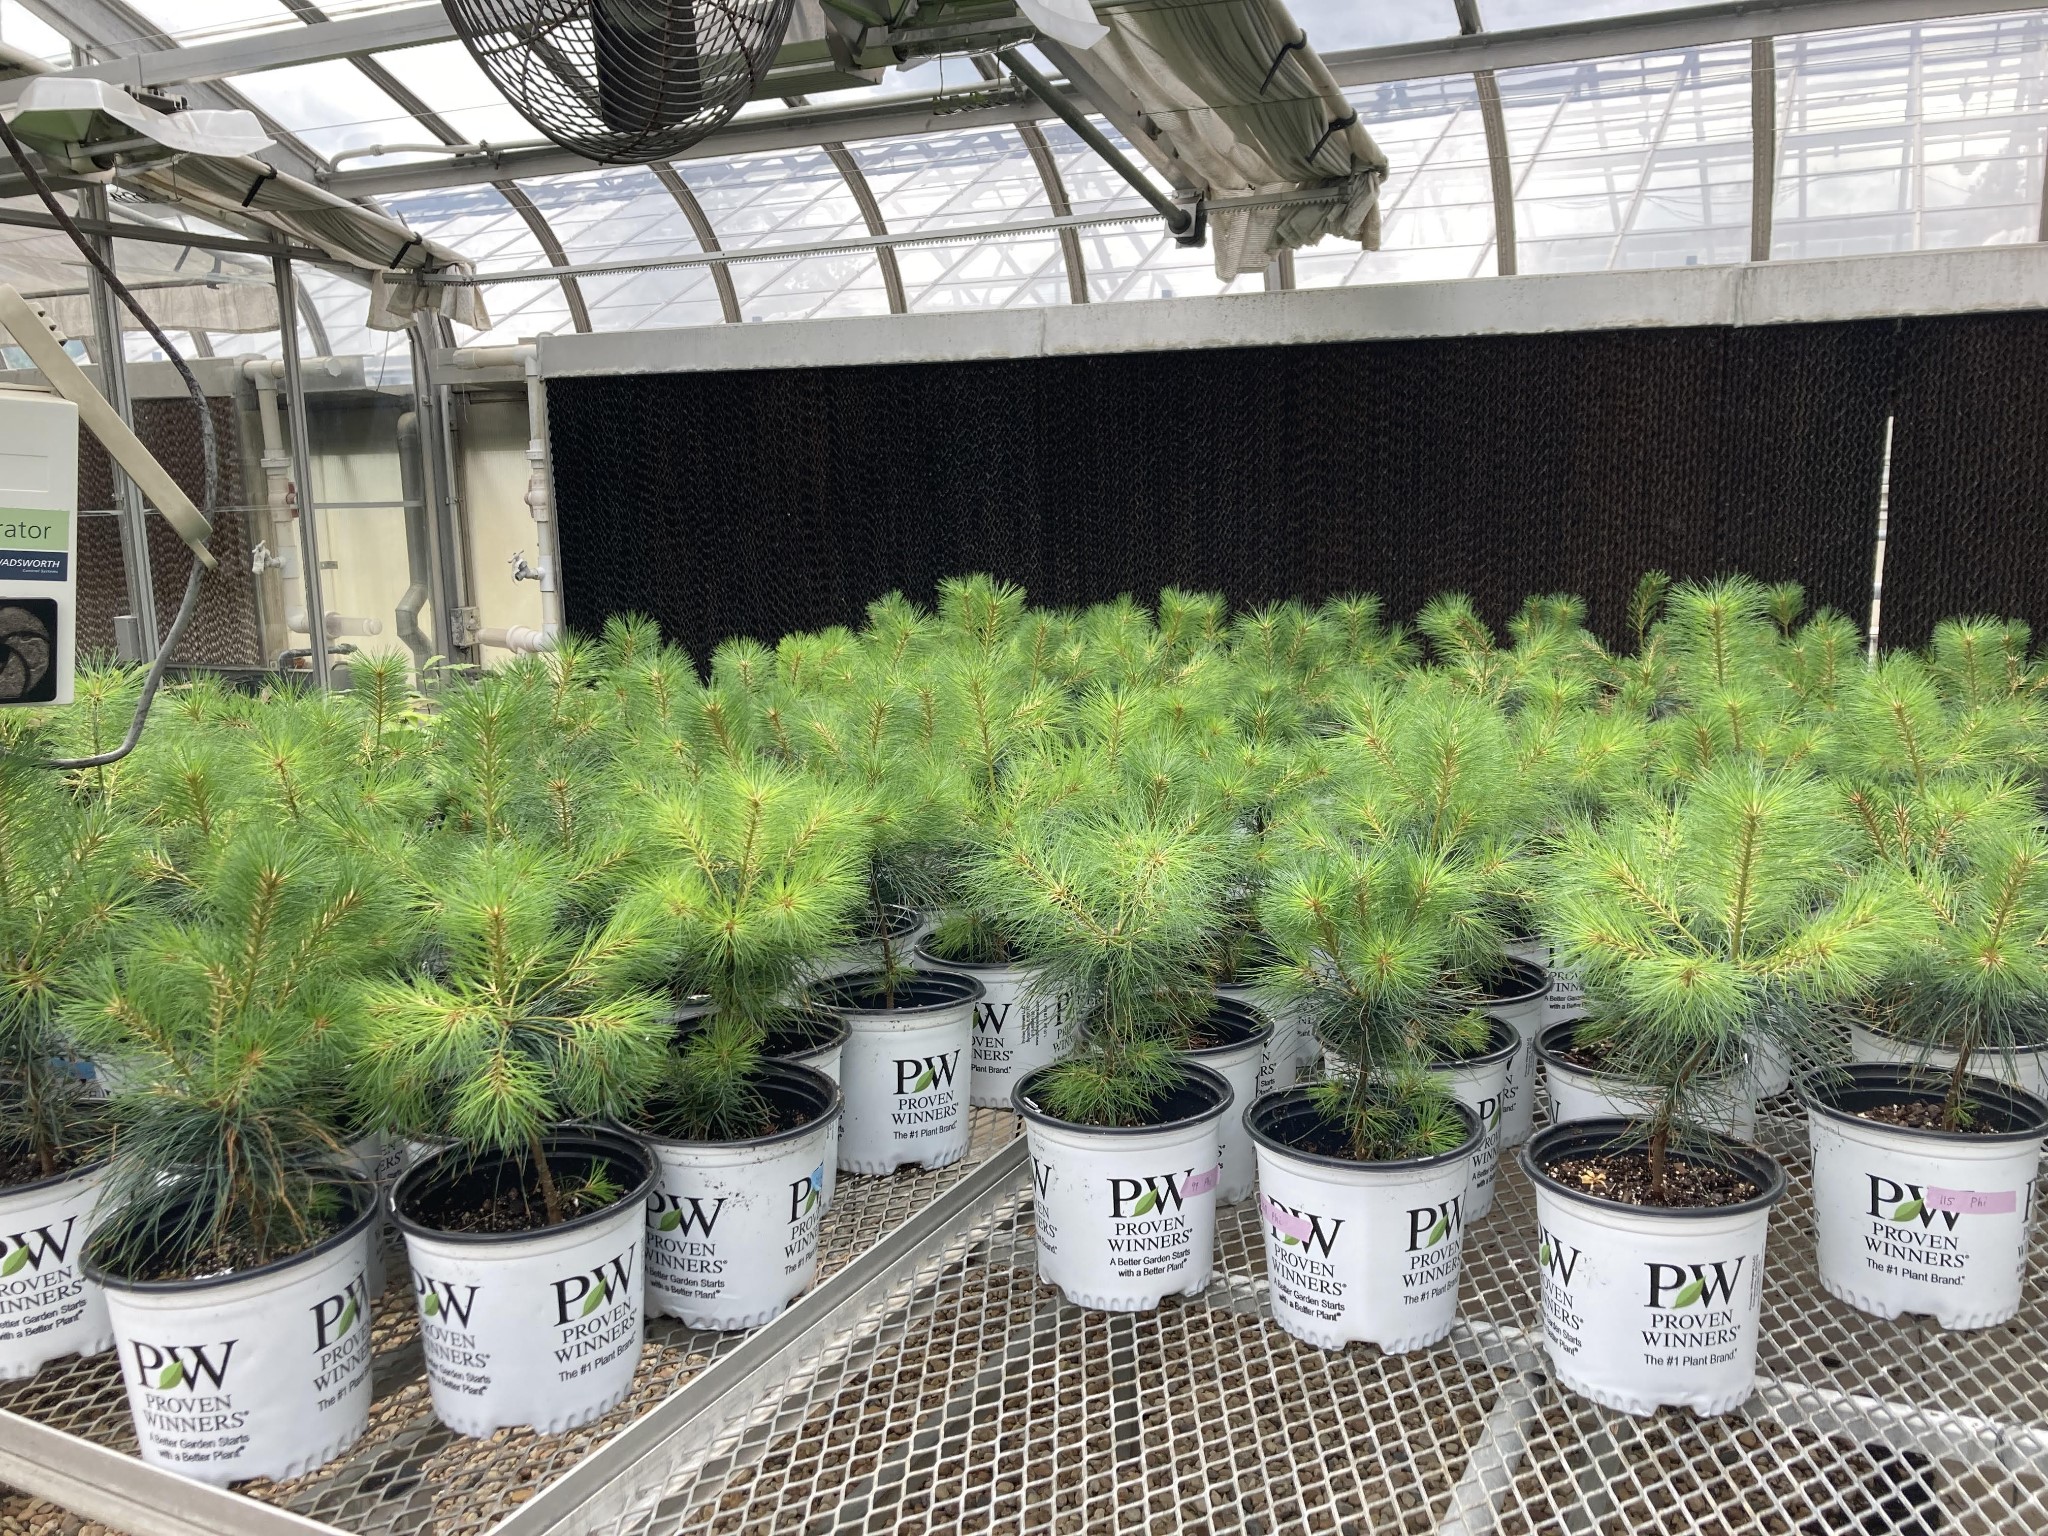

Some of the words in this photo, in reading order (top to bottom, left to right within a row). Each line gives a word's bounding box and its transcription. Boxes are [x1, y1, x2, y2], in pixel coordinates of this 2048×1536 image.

[898, 1090, 954, 1111] PROVEN
[893, 1131, 908, 1139] The
[909, 1130, 919, 1139] #1
[920, 1126, 938, 1138] Plant
[1115, 1214, 1186, 1236] PROVEN
[1872, 1221, 1960, 1251] PROVEN
[646, 1231, 716, 1258] PROVEN
[1410, 1236, 1461, 1271] PROVEN
[1109, 1257, 1117, 1266] A
[1117, 1257, 1142, 1266] Better
[1143, 1254, 1171, 1265] Garden
[1171, 1248, 1191, 1260] Starts
[1274, 1243, 1335, 1279] PROVEN
[670, 1274, 699, 1287] Garden
[700, 1279, 725, 1288] Starts
[1118, 1268, 1135, 1278] with
[1143, 1266, 1166, 1277] Better
[1866, 1257, 1885, 1273] The
[1886, 1264, 1899, 1277] #1
[1901, 1268, 1929, 1283] Plant
[0, 1265, 72, 1298] ROVEN
[550, 1241, 637, 1328] PW
[1643, 1255, 1746, 1309] PW
[1277, 1280, 1292, 1295] Better
[1293, 1290, 1320, 1307] Garden
[1321, 1299, 1346, 1312] Starts
[1403, 1295, 1419, 1306] The
[1420, 1291, 1430, 1301] #1
[1431, 1284, 1447, 1299] Plant
[0, 1316, 20, 1330] etter
[22, 1308, 59, 1326] Garden
[60, 1299, 88, 1315] Starts
[1294, 1302, 1315, 1317] Better
[1650, 1308, 1734, 1330] PROVEN
[16, 1330, 24, 1340] a
[25, 1323, 53, 1338] Better
[561, 1297, 632, 1346] PROVEN
[127, 1338, 240, 1393] PW
[558, 1367, 579, 1383] The
[580, 1360, 593, 1376] #1
[594, 1350, 617, 1370] Plant
[1643, 1353, 1664, 1366] The
[1666, 1355, 1680, 1367] #1
[1682, 1354, 1709, 1367] Plant
[145, 1392, 232, 1414] PROVEN
[317, 1393, 336, 1413] The
[179, 1438, 217, 1450] Garden
[217, 1434, 250, 1448] Starts
[182, 1451, 211, 1463] Better
